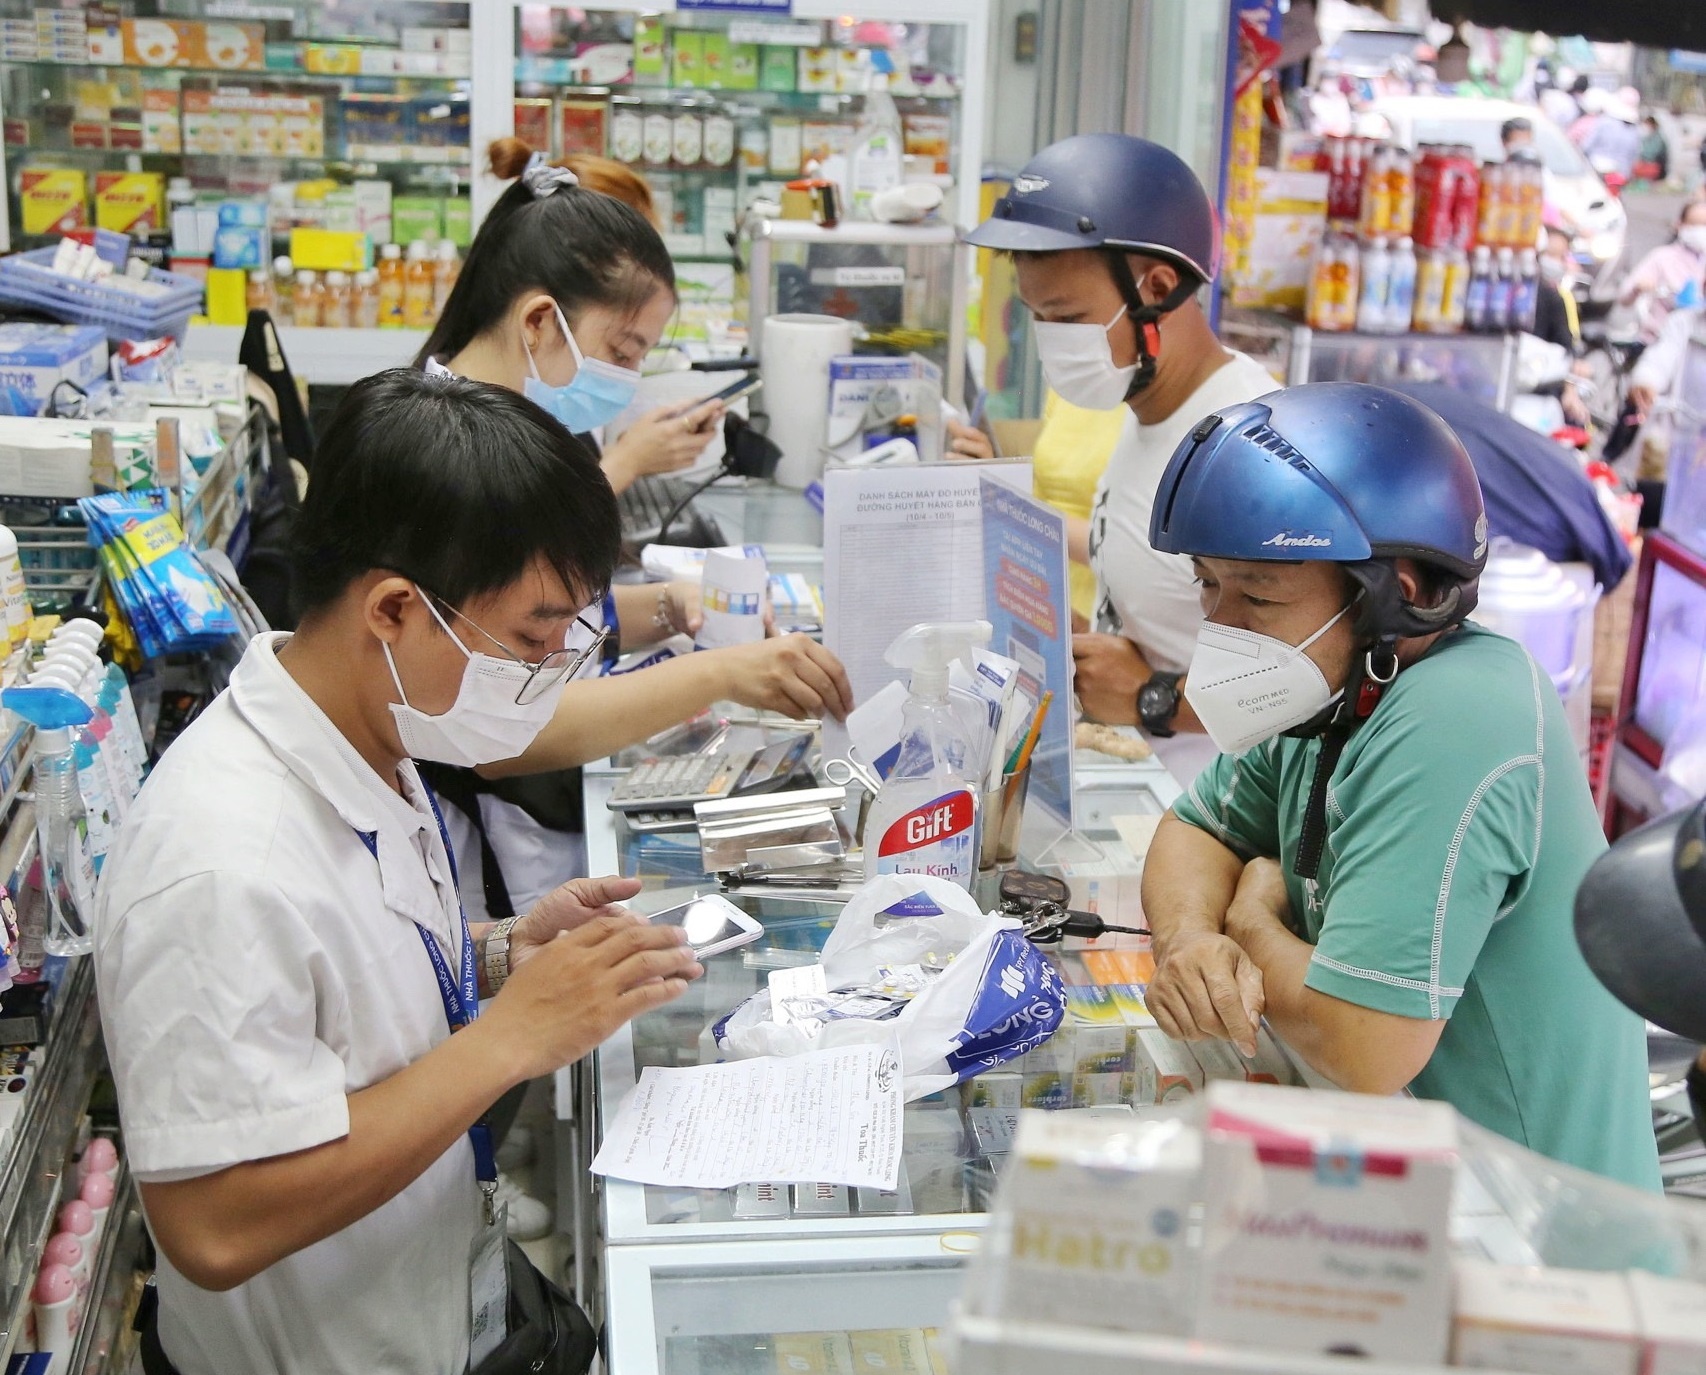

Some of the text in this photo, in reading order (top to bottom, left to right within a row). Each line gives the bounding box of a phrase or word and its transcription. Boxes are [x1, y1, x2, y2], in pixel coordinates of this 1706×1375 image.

[859, 492, 886, 501] DANH
[1027, 515, 1044, 533] LONG
[1261, 533, 1331, 546] Andos
[907, 804, 953, 844] Gift
[428, 941, 442, 966] LONG
[463, 945, 473, 979] THUỐC
[438, 965, 453, 996] THUỐC
[463, 981, 473, 1001] NHÀ
[449, 994, 460, 1014] NHÀ
[858, 1123, 869, 1163] Toa Thuốc
